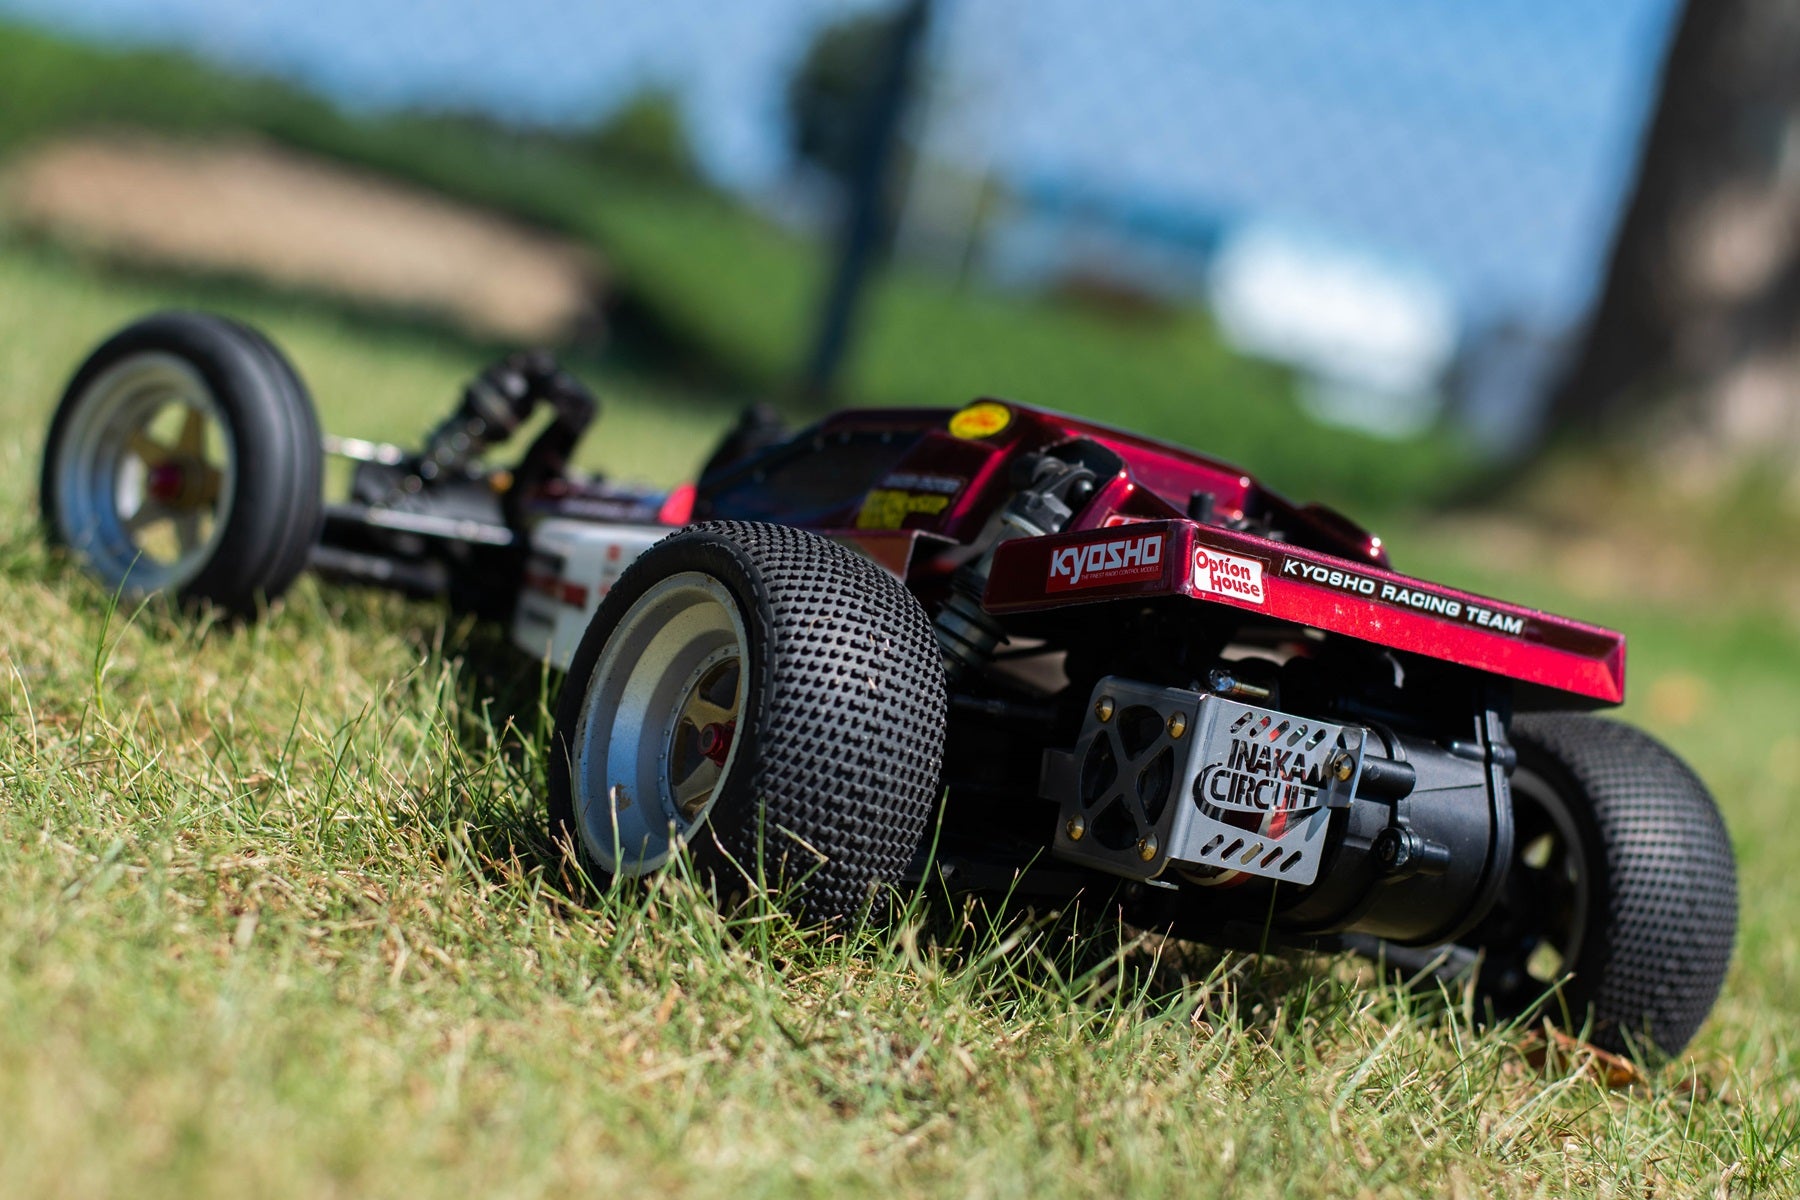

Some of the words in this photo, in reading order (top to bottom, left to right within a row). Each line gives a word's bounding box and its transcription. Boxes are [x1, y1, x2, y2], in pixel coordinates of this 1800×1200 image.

[1050, 535, 1162, 584] KYOSHO
[1195, 551, 1251, 580] Option
[1210, 573, 1260, 597] House
[1284, 559, 1375, 594] KYOSHO
[1381, 584, 1461, 617] RACING
[1466, 606, 1524, 634] TEAM
[1227, 738, 1306, 782] INAKA
[1210, 769, 1318, 810] CIRCUIT
